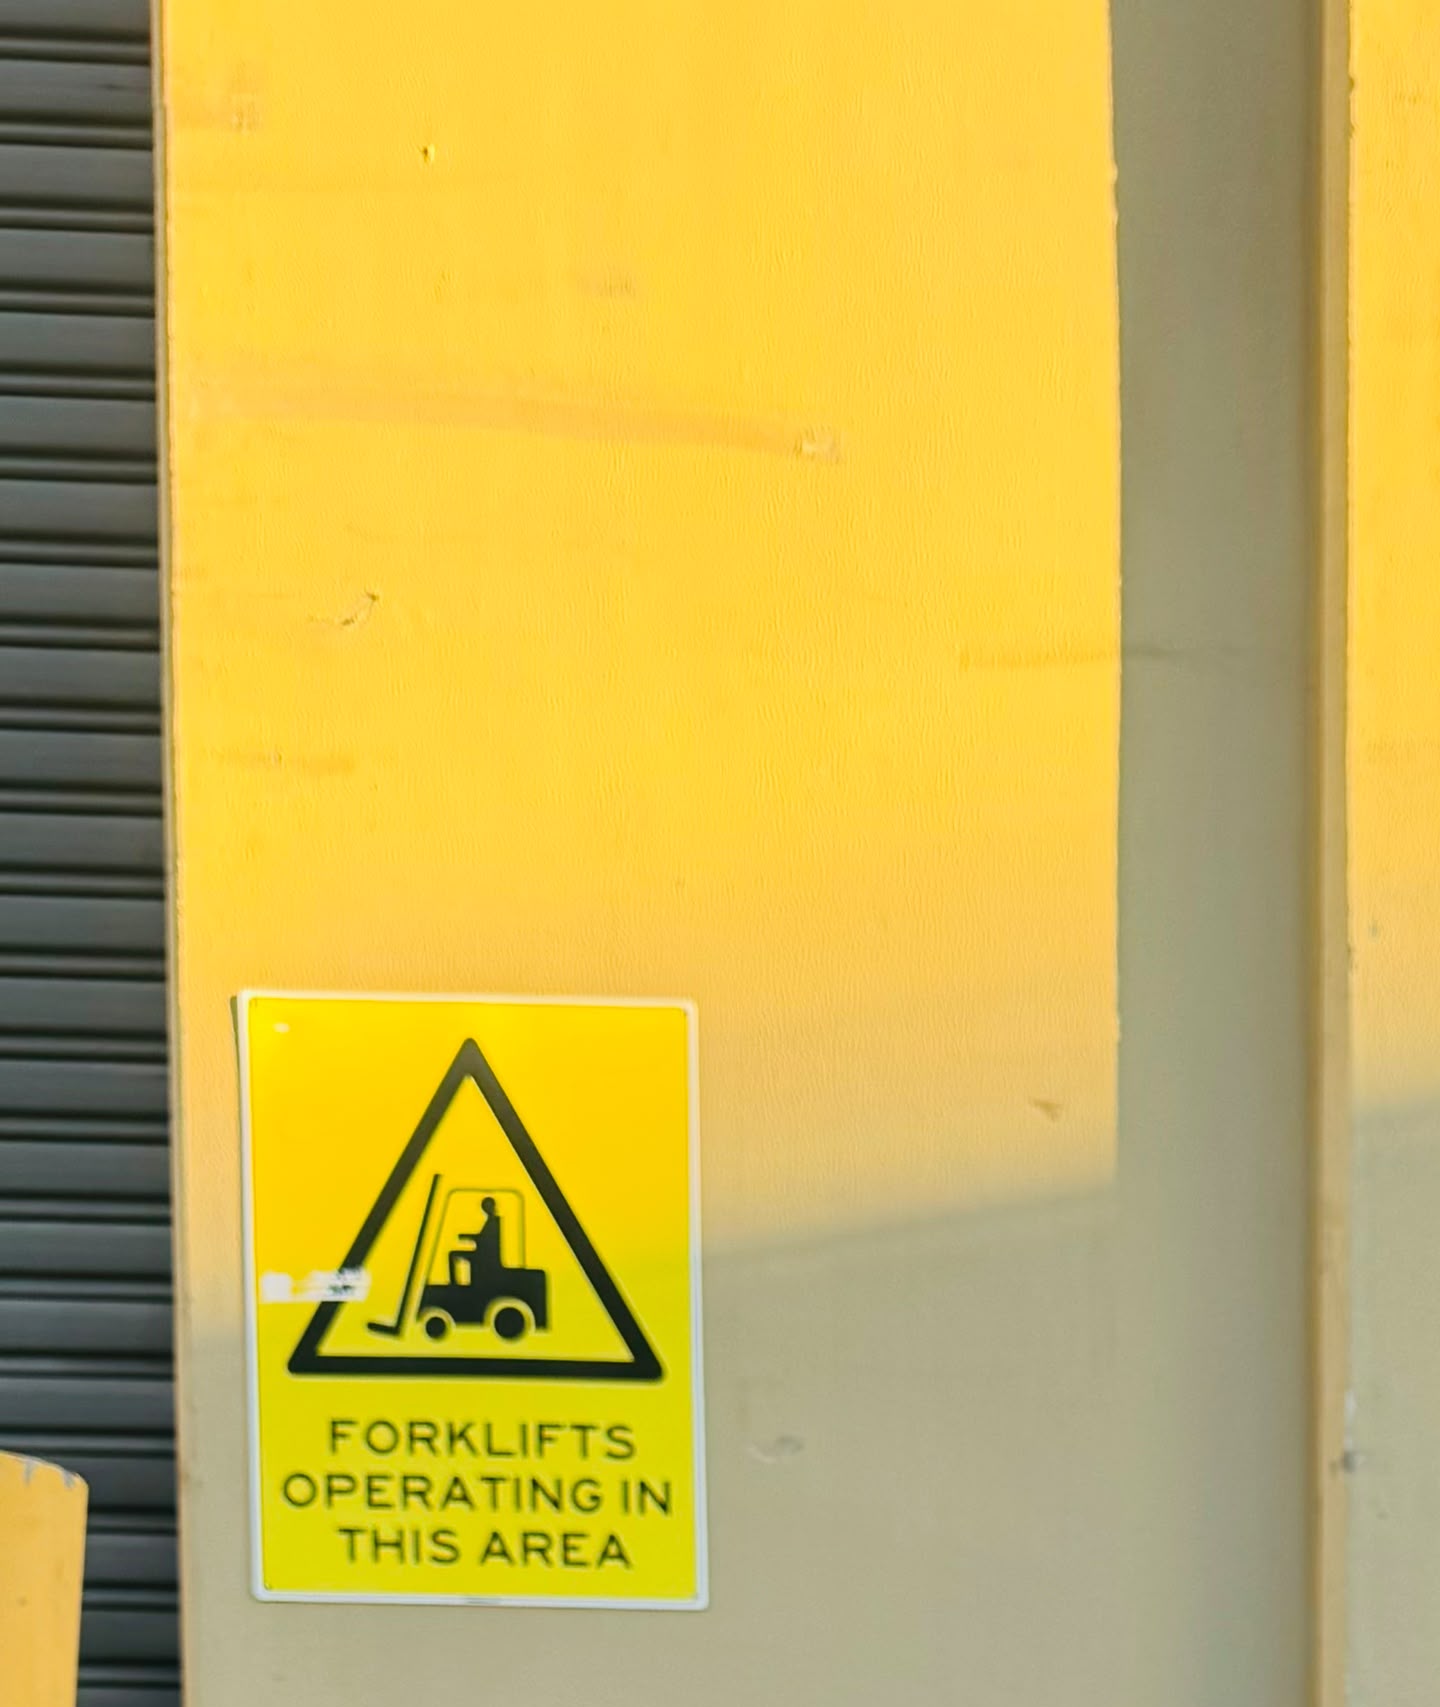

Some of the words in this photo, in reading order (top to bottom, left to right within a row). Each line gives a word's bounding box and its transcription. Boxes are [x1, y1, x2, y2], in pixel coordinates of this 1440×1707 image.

[330, 1418, 635, 1460] FORKLIFTS
[282, 1472, 602, 1513] OPERATING
[622, 1480, 670, 1515] IN
[338, 1527, 460, 1565] THIS
[480, 1531, 630, 1568] AREA
